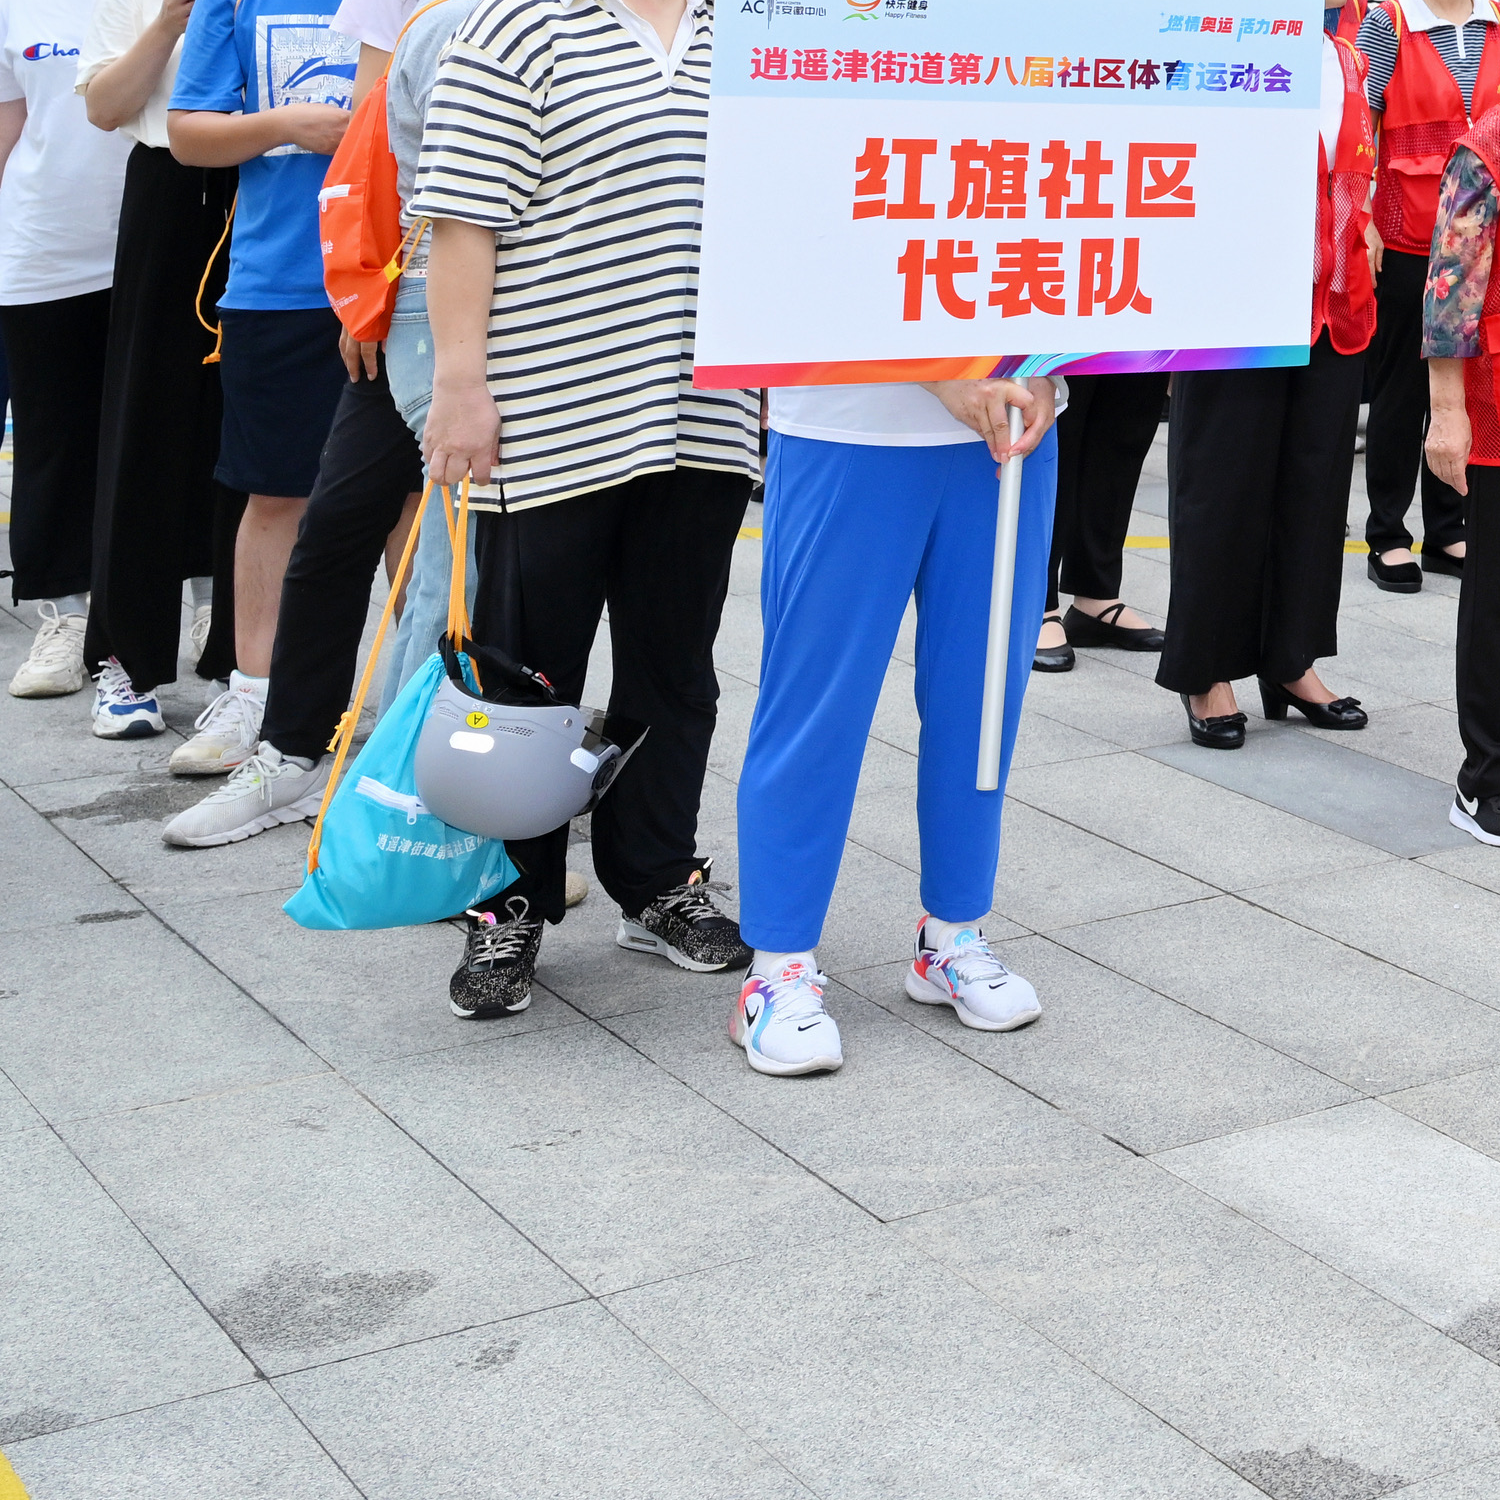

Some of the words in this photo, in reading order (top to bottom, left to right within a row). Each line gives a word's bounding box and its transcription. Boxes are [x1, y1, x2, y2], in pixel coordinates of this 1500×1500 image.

[740, 0, 765, 14] AC
[781, 5, 827, 17] 安徽中心
[885, 11, 904, 19] Happy
[1159, 14, 1234, 34] 燃情奥运
[1236, 17, 1303, 43] 活力庐阳
[750, 46, 1293, 94] 逍遥津街道第八届社区体育运动会
[852, 137, 1197, 221] 红旗社区
[897, 237, 1153, 322] 代表队
